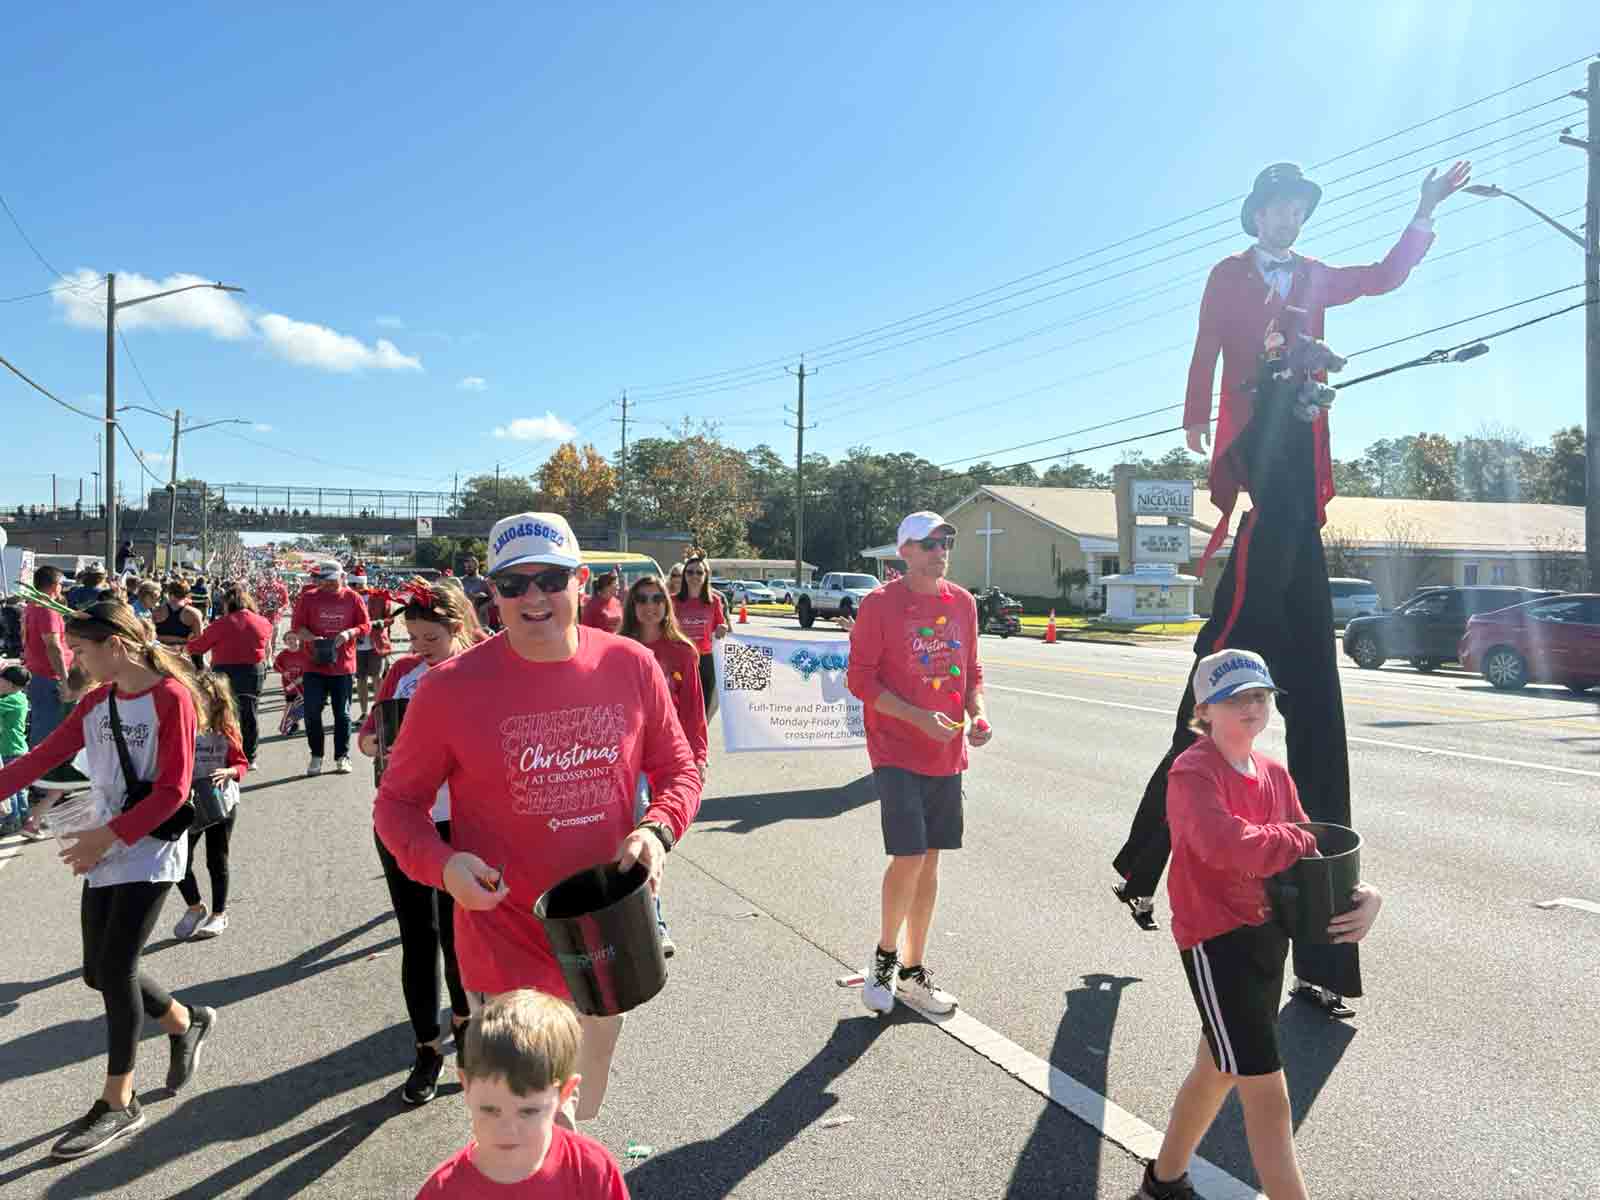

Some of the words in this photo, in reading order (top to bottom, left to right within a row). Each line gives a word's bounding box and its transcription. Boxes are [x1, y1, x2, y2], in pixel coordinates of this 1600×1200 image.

[1137, 495, 1190, 506] NICEVILLE
[748, 703, 792, 713] Full-Time
[795, 703, 813, 713] and
[815, 703, 860, 713] Part-Time
[769, 717, 840, 729] Monday-Friday
[519, 743, 619, 772] Christmas
[531, 775, 544, 785] AT
[547, 767, 610, 784] CROSSPOINT
[560, 811, 606, 827] crosspoint
